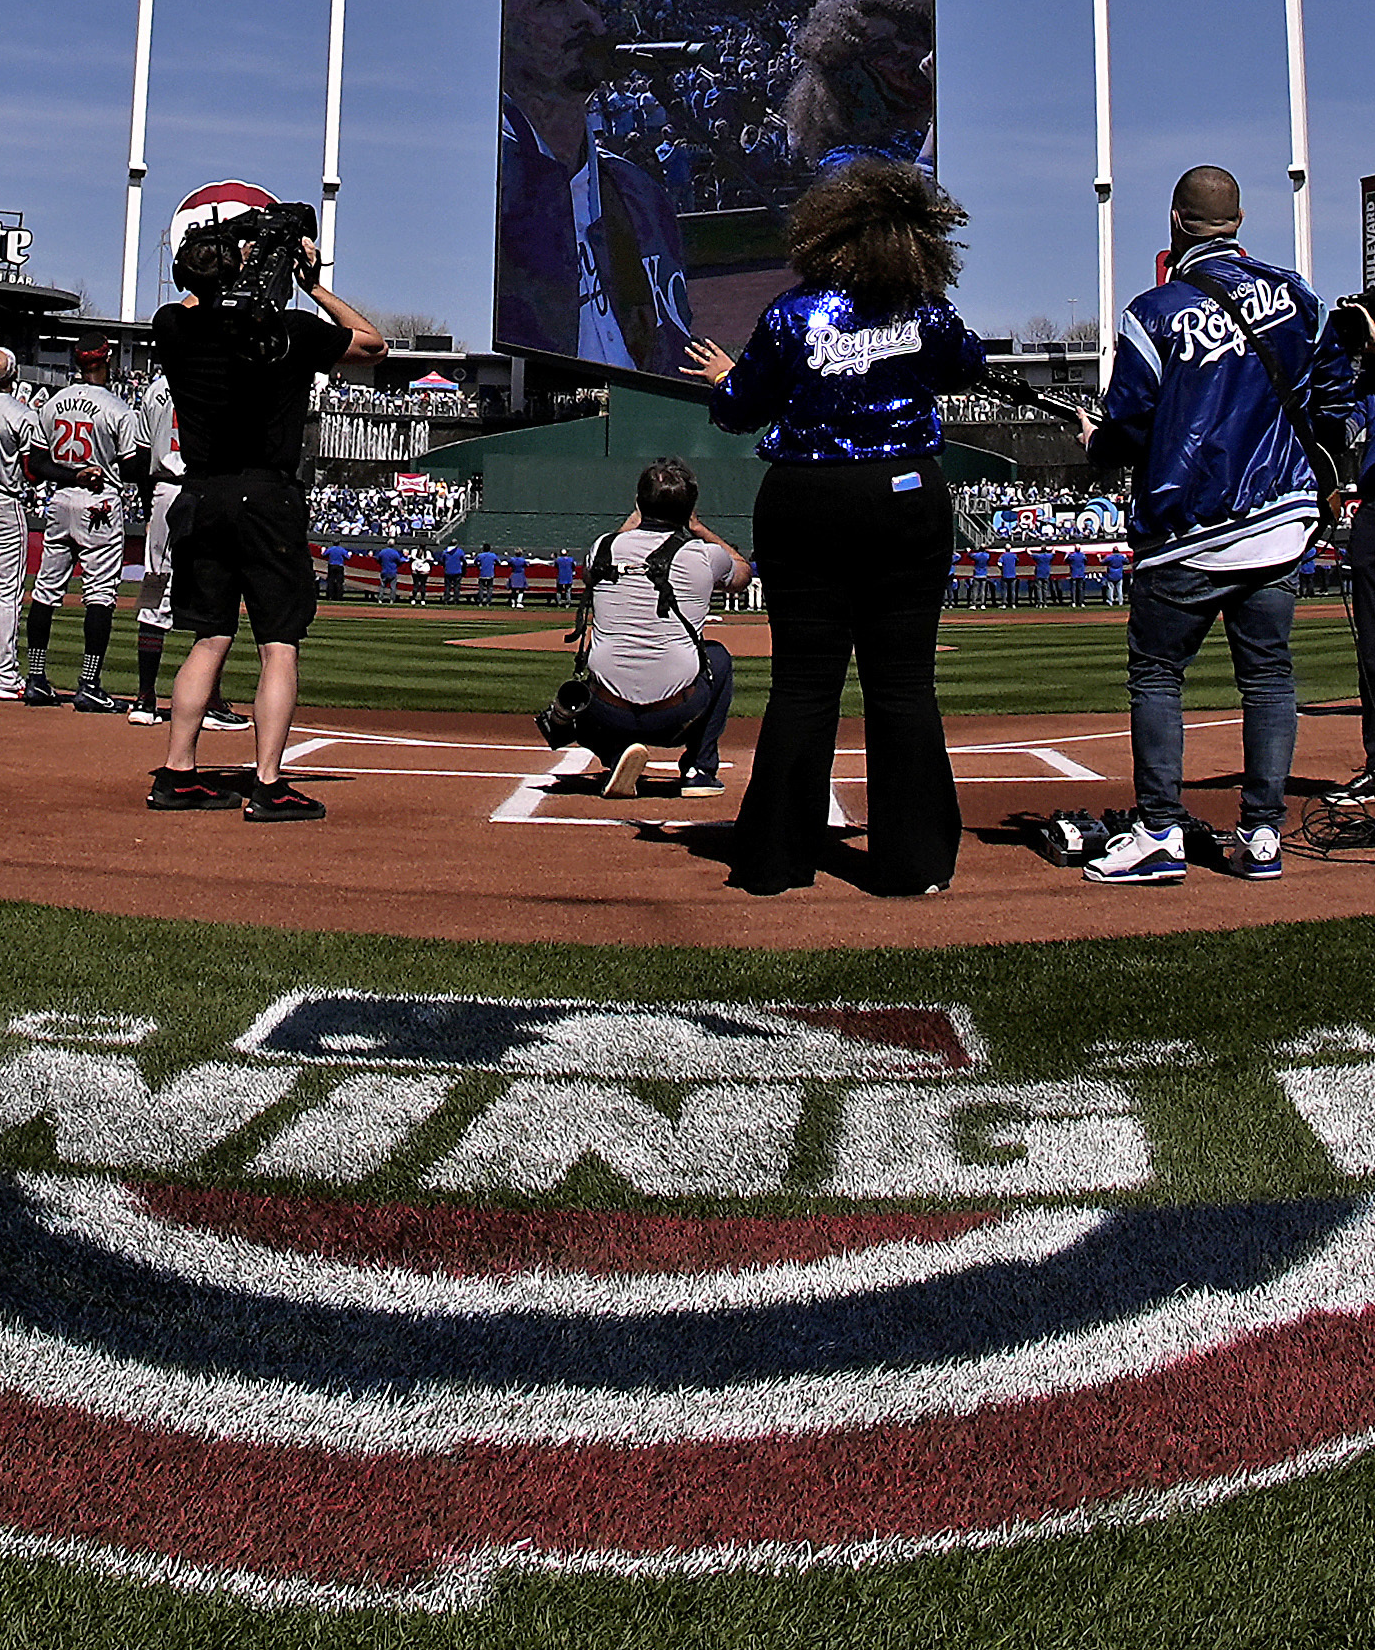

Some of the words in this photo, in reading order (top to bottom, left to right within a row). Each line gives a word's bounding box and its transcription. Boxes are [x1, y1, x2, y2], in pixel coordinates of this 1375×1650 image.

[8, 273, 34, 288] BAR
[1171, 278, 1297, 367] Royals
[805, 319, 923, 376] Royals
[55, 399, 101, 418] BUXTON
[53, 418, 94, 462] 25
